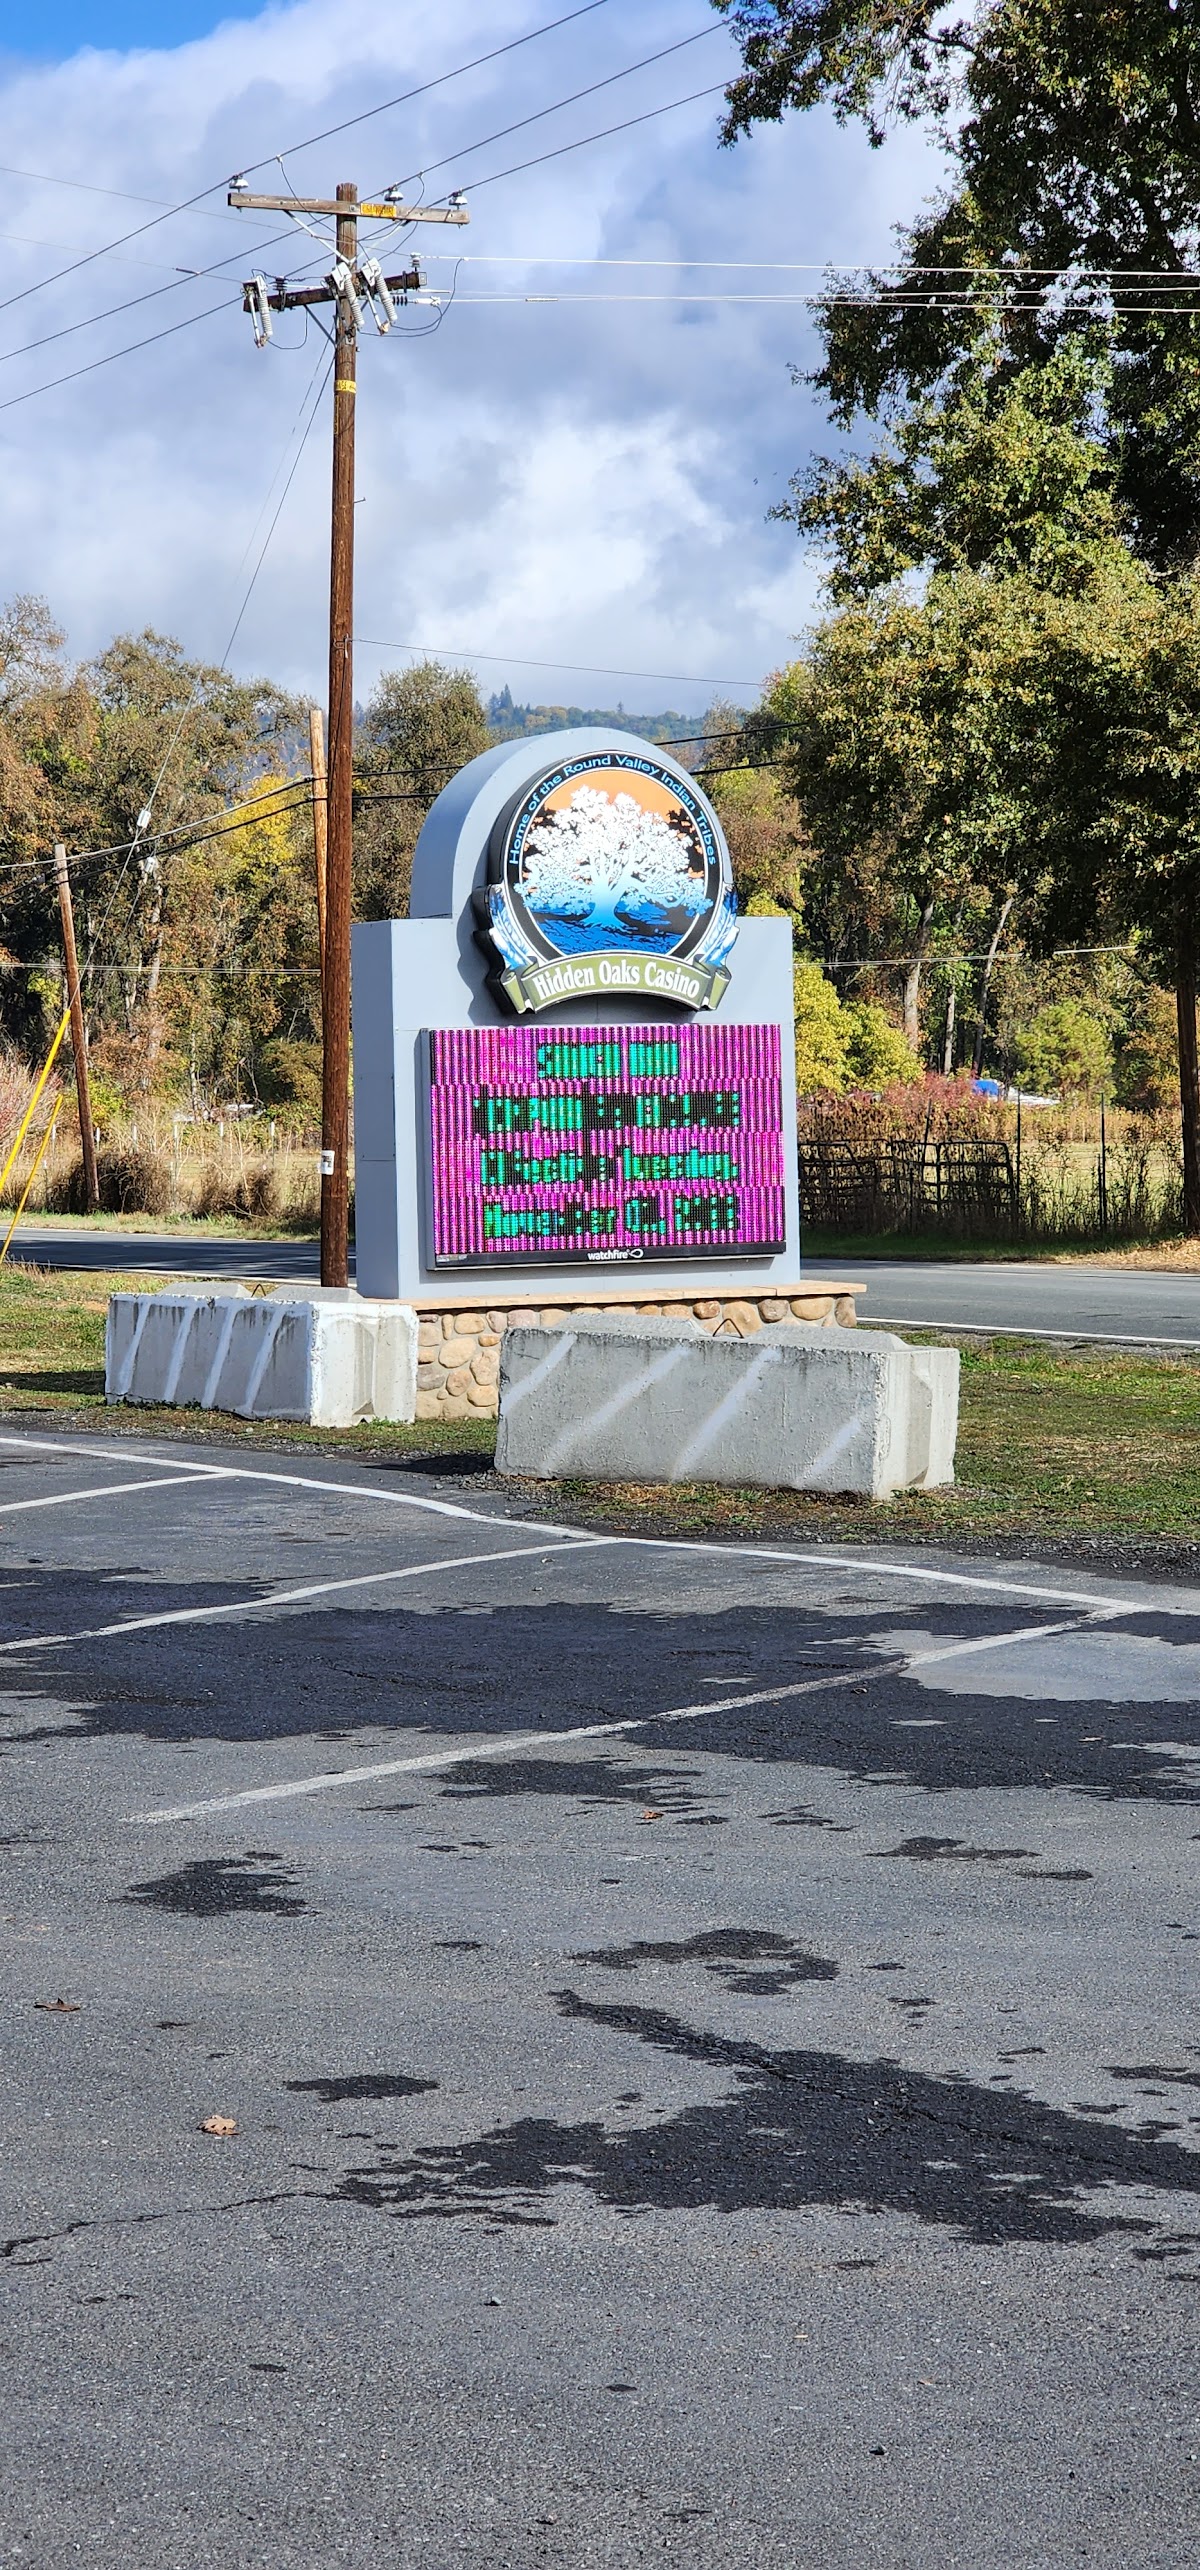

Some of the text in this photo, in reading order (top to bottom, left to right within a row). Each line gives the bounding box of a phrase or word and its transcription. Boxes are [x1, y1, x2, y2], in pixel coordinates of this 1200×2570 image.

[509, 755, 716, 866] Home of the Round Valley Indian Tribes
[532, 958, 700, 1001] Hidden Oaks Casino
[483, 1203, 616, 1238] Noveer
[587, 1249, 629, 1261] watchfire
